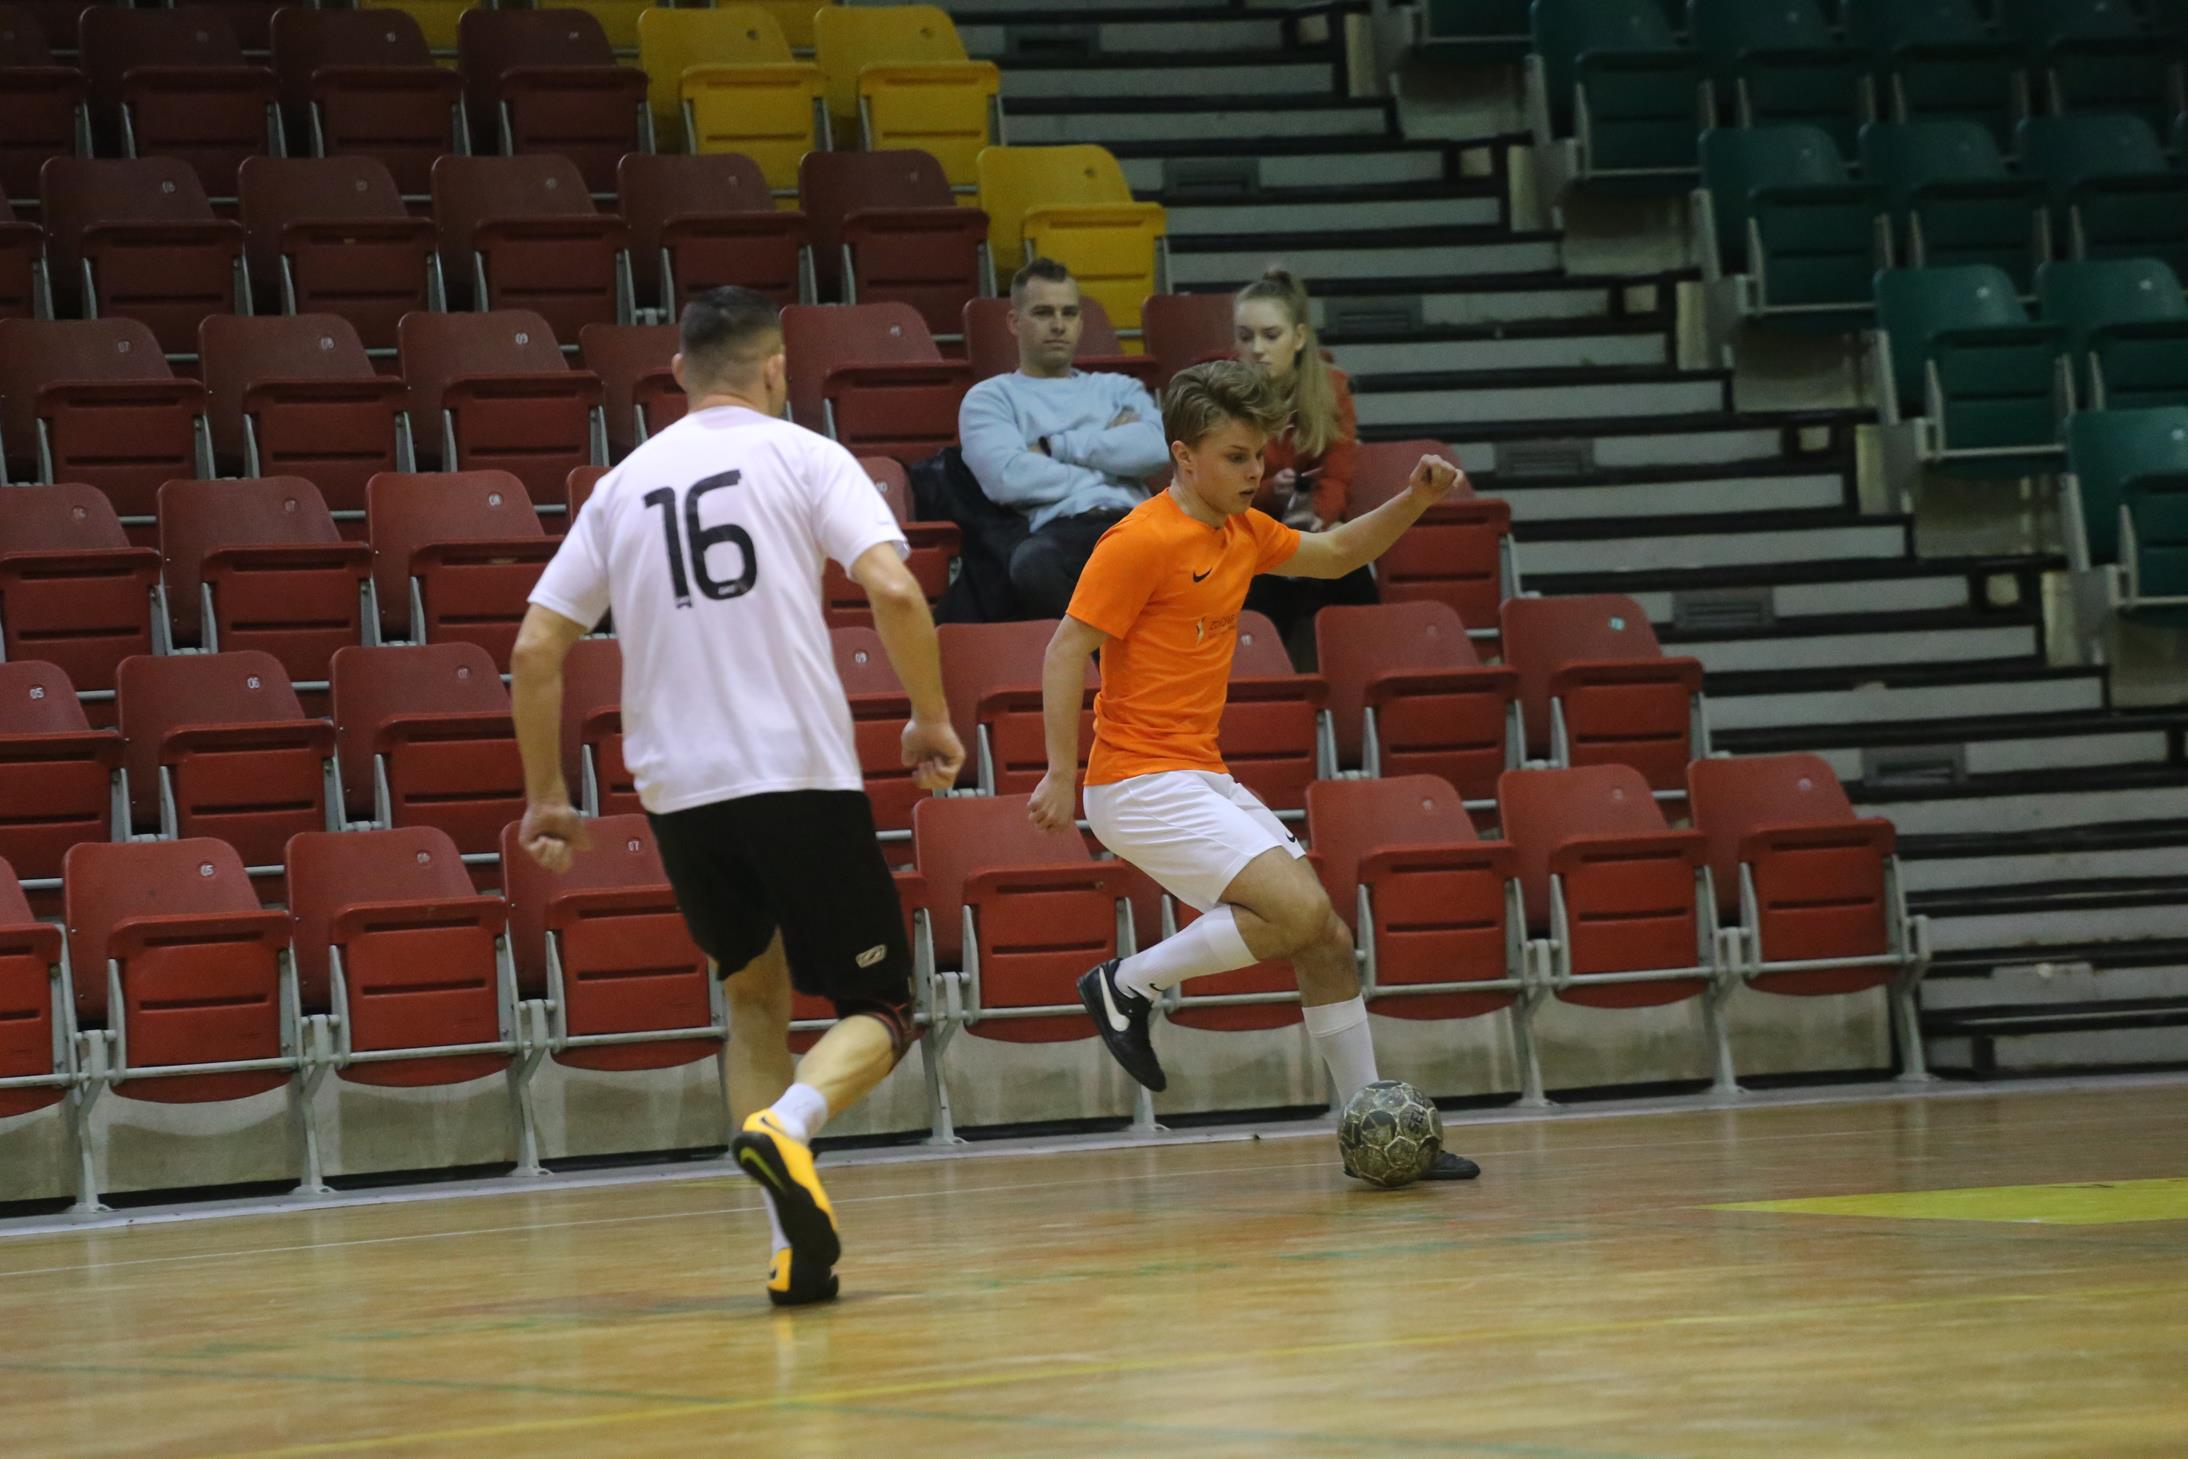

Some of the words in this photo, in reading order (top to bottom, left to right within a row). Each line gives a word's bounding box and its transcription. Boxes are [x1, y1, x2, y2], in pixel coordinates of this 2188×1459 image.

[117, 341, 130, 352] 07
[644, 469, 757, 608] 16
[246, 677, 260, 690] 06
[30, 687, 44, 700] 05
[627, 840, 640, 852] 07
[200, 864, 214, 877] 05
